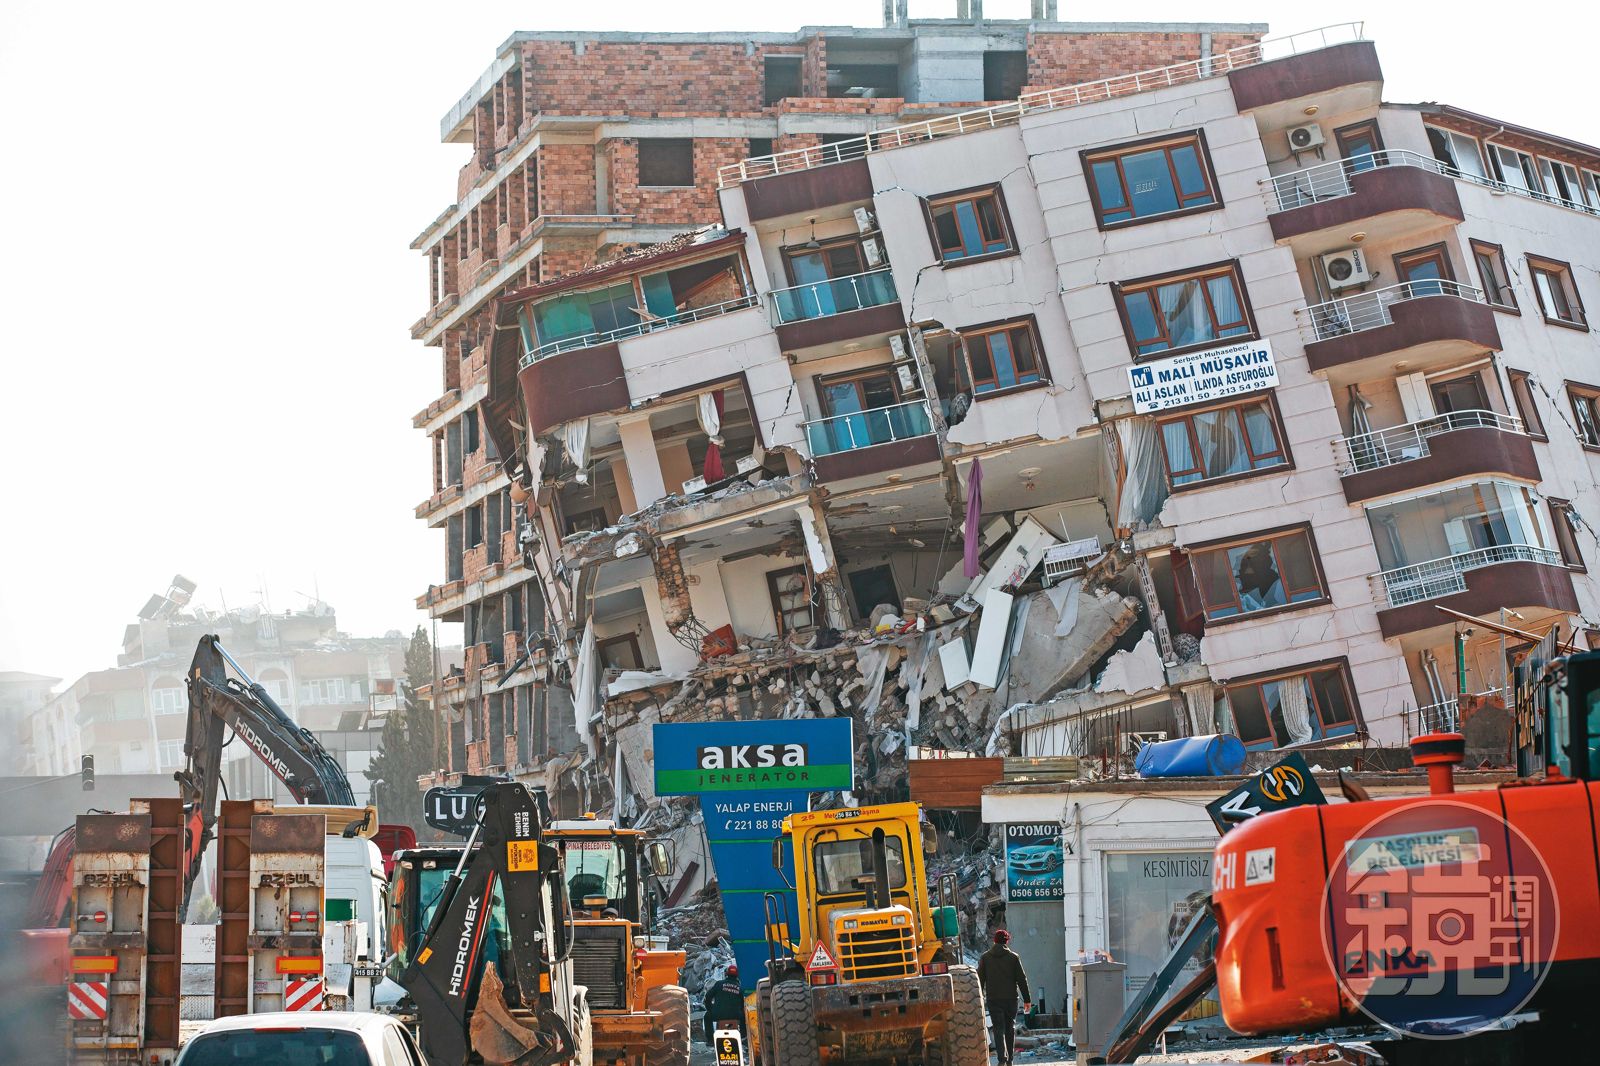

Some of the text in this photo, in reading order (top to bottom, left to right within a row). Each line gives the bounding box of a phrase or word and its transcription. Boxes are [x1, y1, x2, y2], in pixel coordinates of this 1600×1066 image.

[1173, 344, 1249, 365] Serbest Muhasebeci
[1158, 349, 1269, 383] MALİ MÜŞAVİR
[1194, 365, 1275, 391] İLAYDA ASFUROĞLU
[1136, 383, 1187, 404] ALİ ASLAN
[1164, 399, 1181, 407] 213
[1198, 392, 1210, 400] 50
[1219, 387, 1237, 395] 213
[1239, 384, 1251, 392] 54
[1254, 381, 1267, 389] 93
[701, 743, 805, 770] aksa
[699, 770, 809, 786] JENERATÖR
[715, 799, 793, 813] YALAP ENERJİ
[522, 811, 530, 837] BENİM
[734, 819, 783, 830] 221 88 80
[1143, 857, 1209, 877] KESİNTİSİZ
[1017, 876, 1046, 886] Önder
[1012, 889, 1032, 897] 0506
[1035, 888, 1050, 897] 656
[1344, 947, 1437, 974] ENKA
